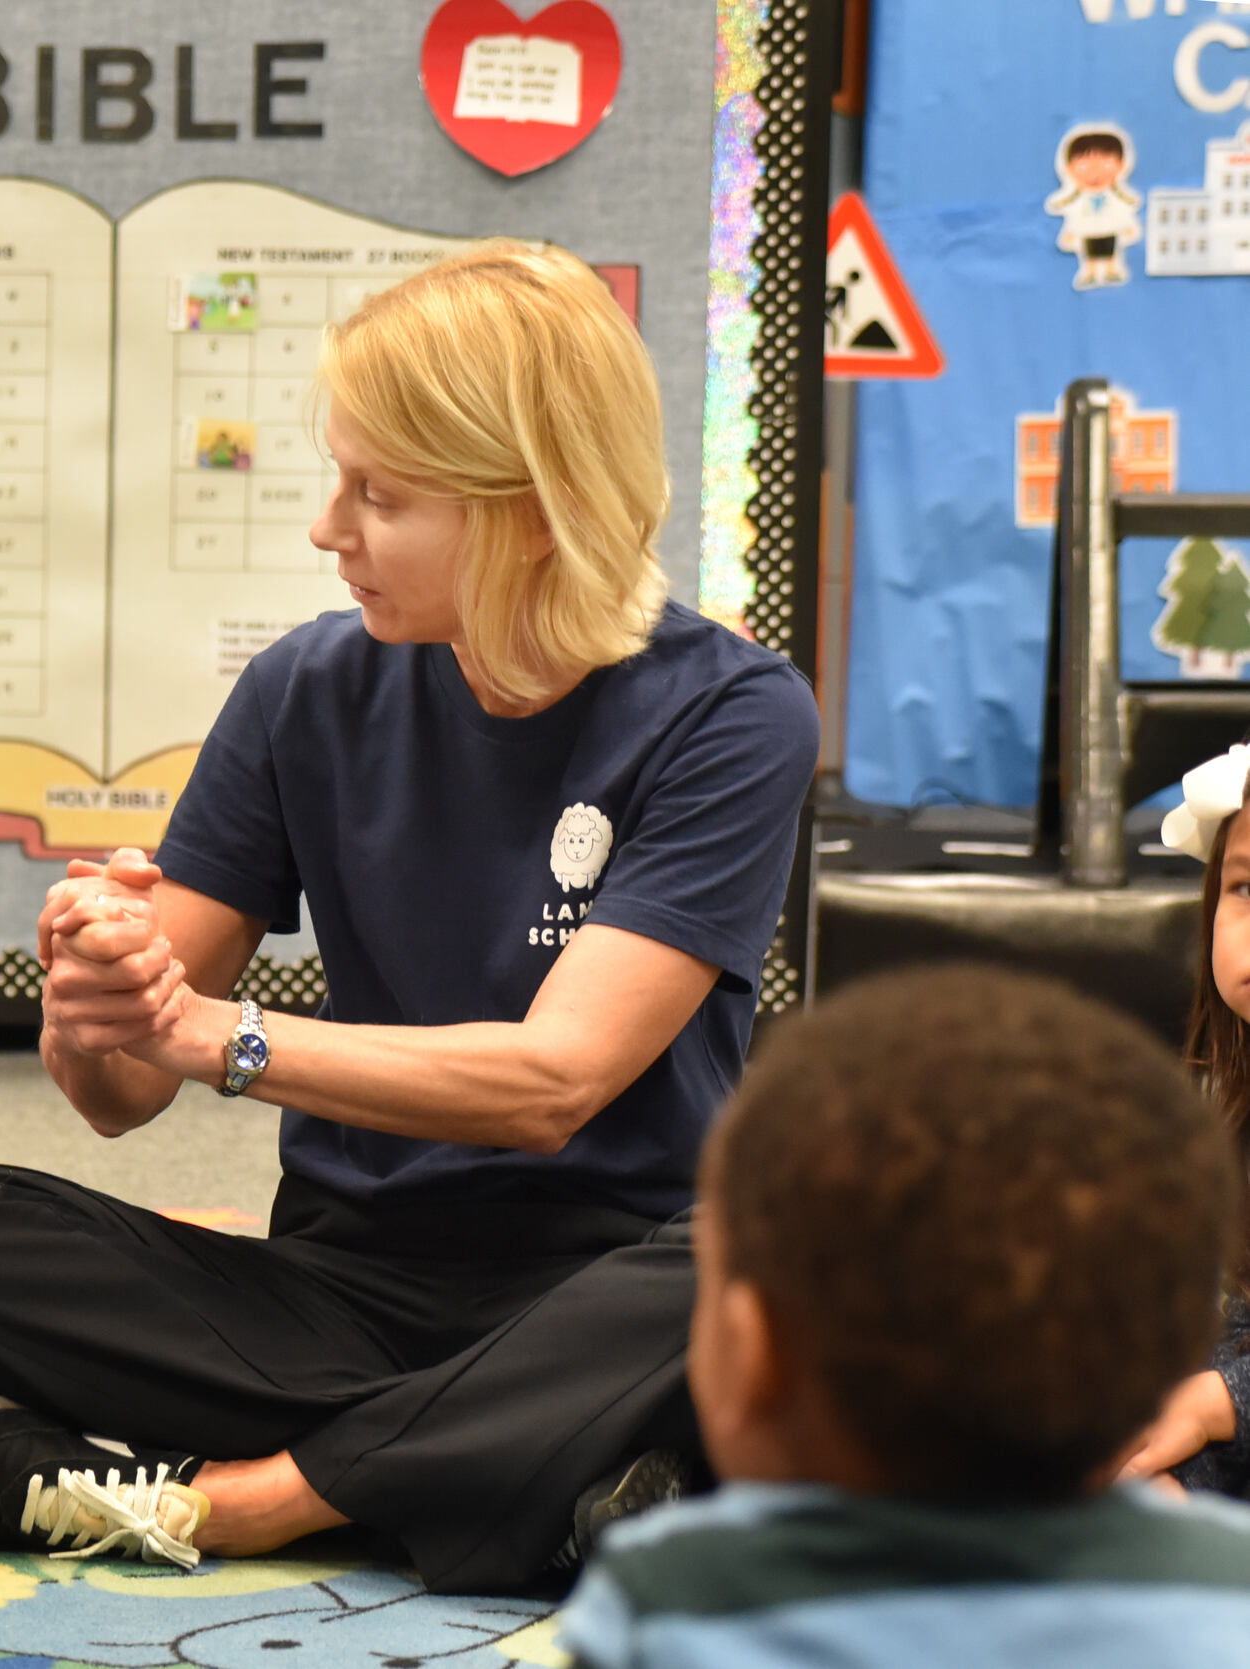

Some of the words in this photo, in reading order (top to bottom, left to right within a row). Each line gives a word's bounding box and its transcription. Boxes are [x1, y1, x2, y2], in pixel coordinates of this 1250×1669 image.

[1174, 21, 1250, 113] C
[217, 247, 253, 263] NEW
[260, 247, 354, 263] TESTAMENT
[46, 789, 102, 808] HOLY
[109, 791, 168, 810] BIBLE
[543, 900, 593, 921] LAM
[528, 926, 576, 947] SCH
